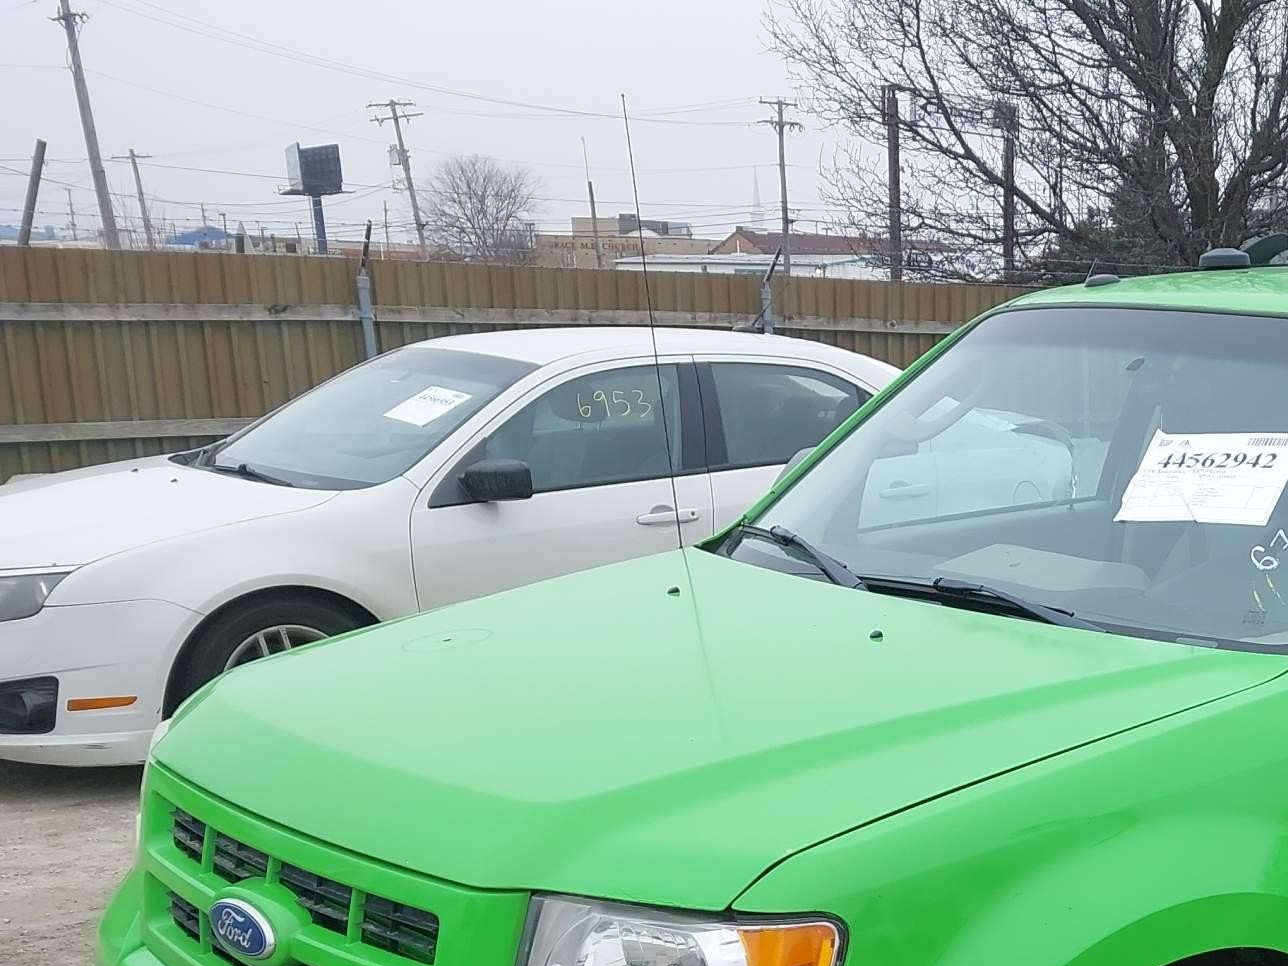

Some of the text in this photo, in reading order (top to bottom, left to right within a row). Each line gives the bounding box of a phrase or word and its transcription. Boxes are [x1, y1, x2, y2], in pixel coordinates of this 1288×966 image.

[577, 390, 651, 417] 6953
[1158, 452, 1278, 469] 44562942
[217, 908, 255, 948] Ford
